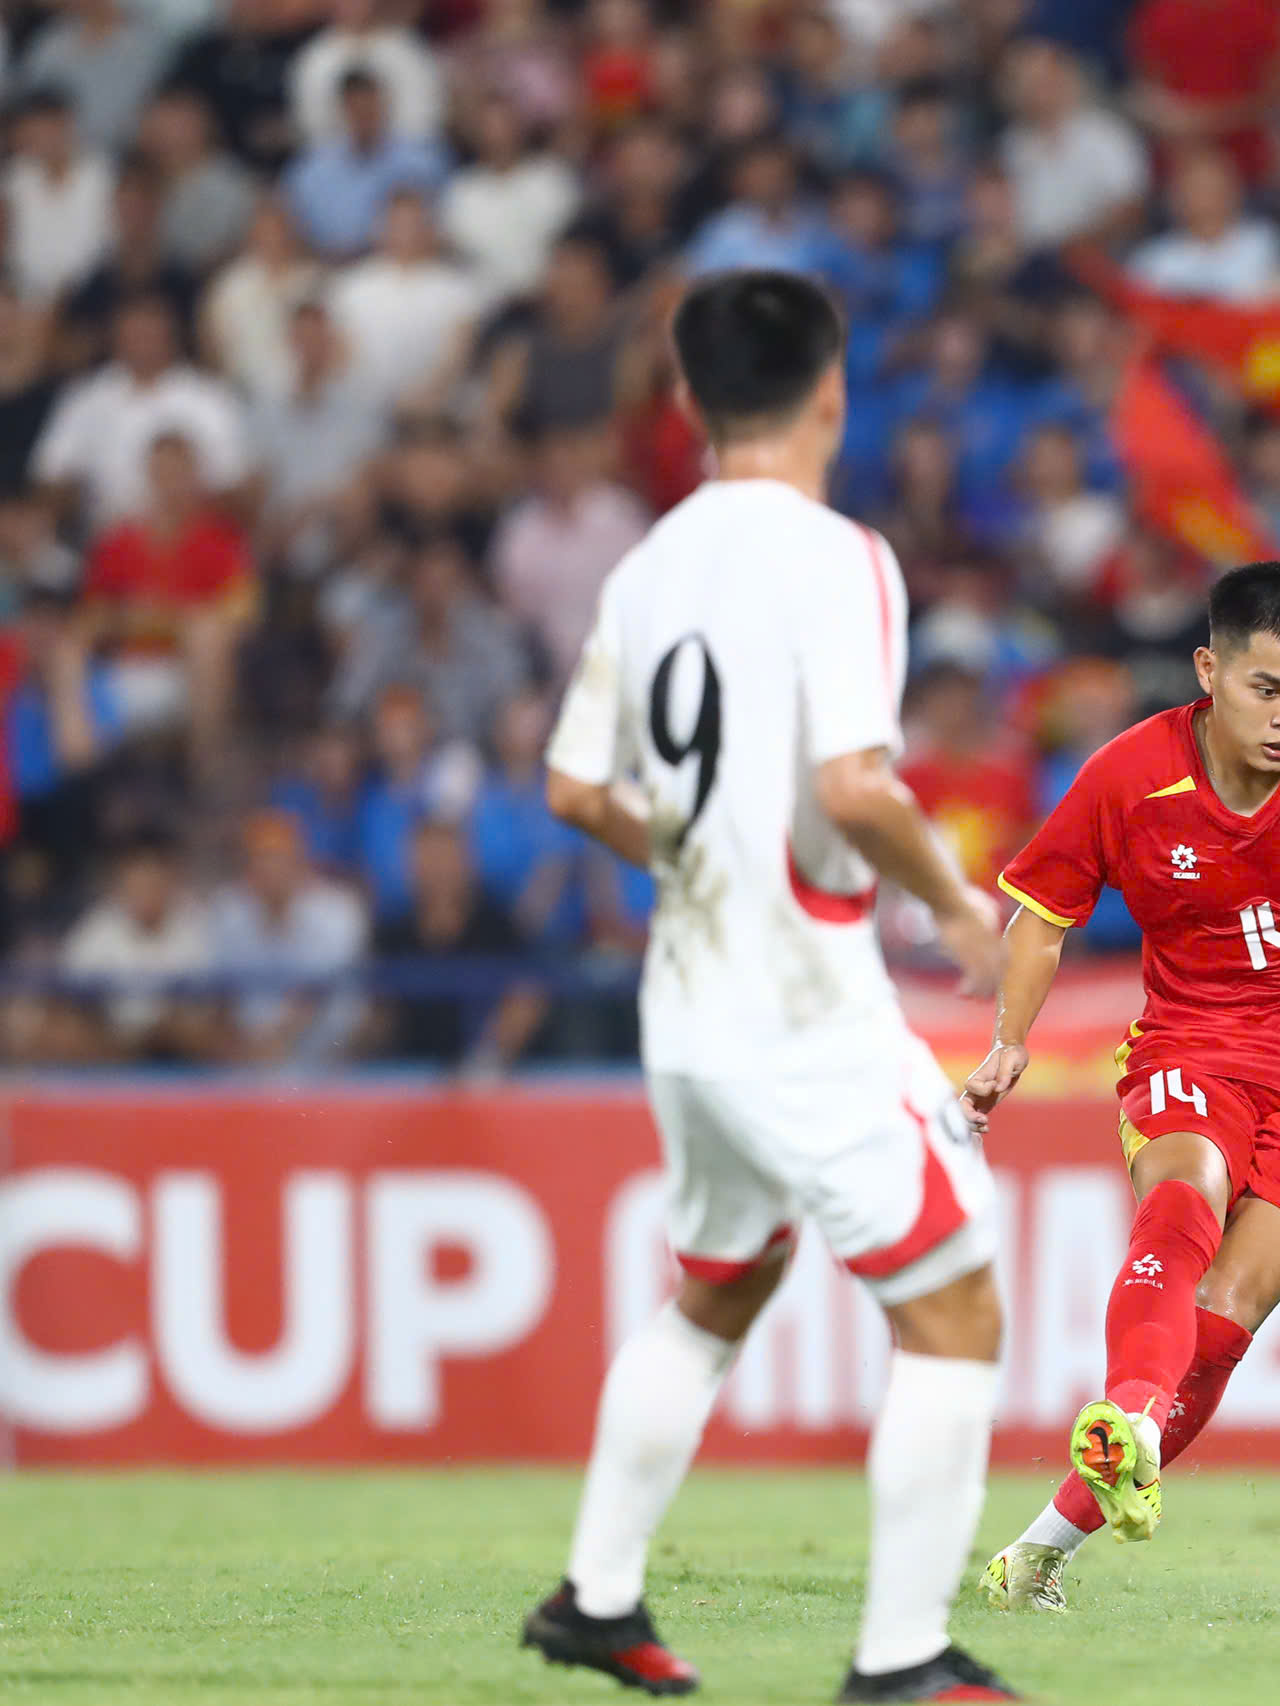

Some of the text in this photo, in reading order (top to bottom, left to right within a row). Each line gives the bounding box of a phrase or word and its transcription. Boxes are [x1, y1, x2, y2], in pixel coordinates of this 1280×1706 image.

[649, 630, 722, 858] 9
[1149, 1067, 1208, 1118] 14
[0, 1167, 555, 1434] CUP
